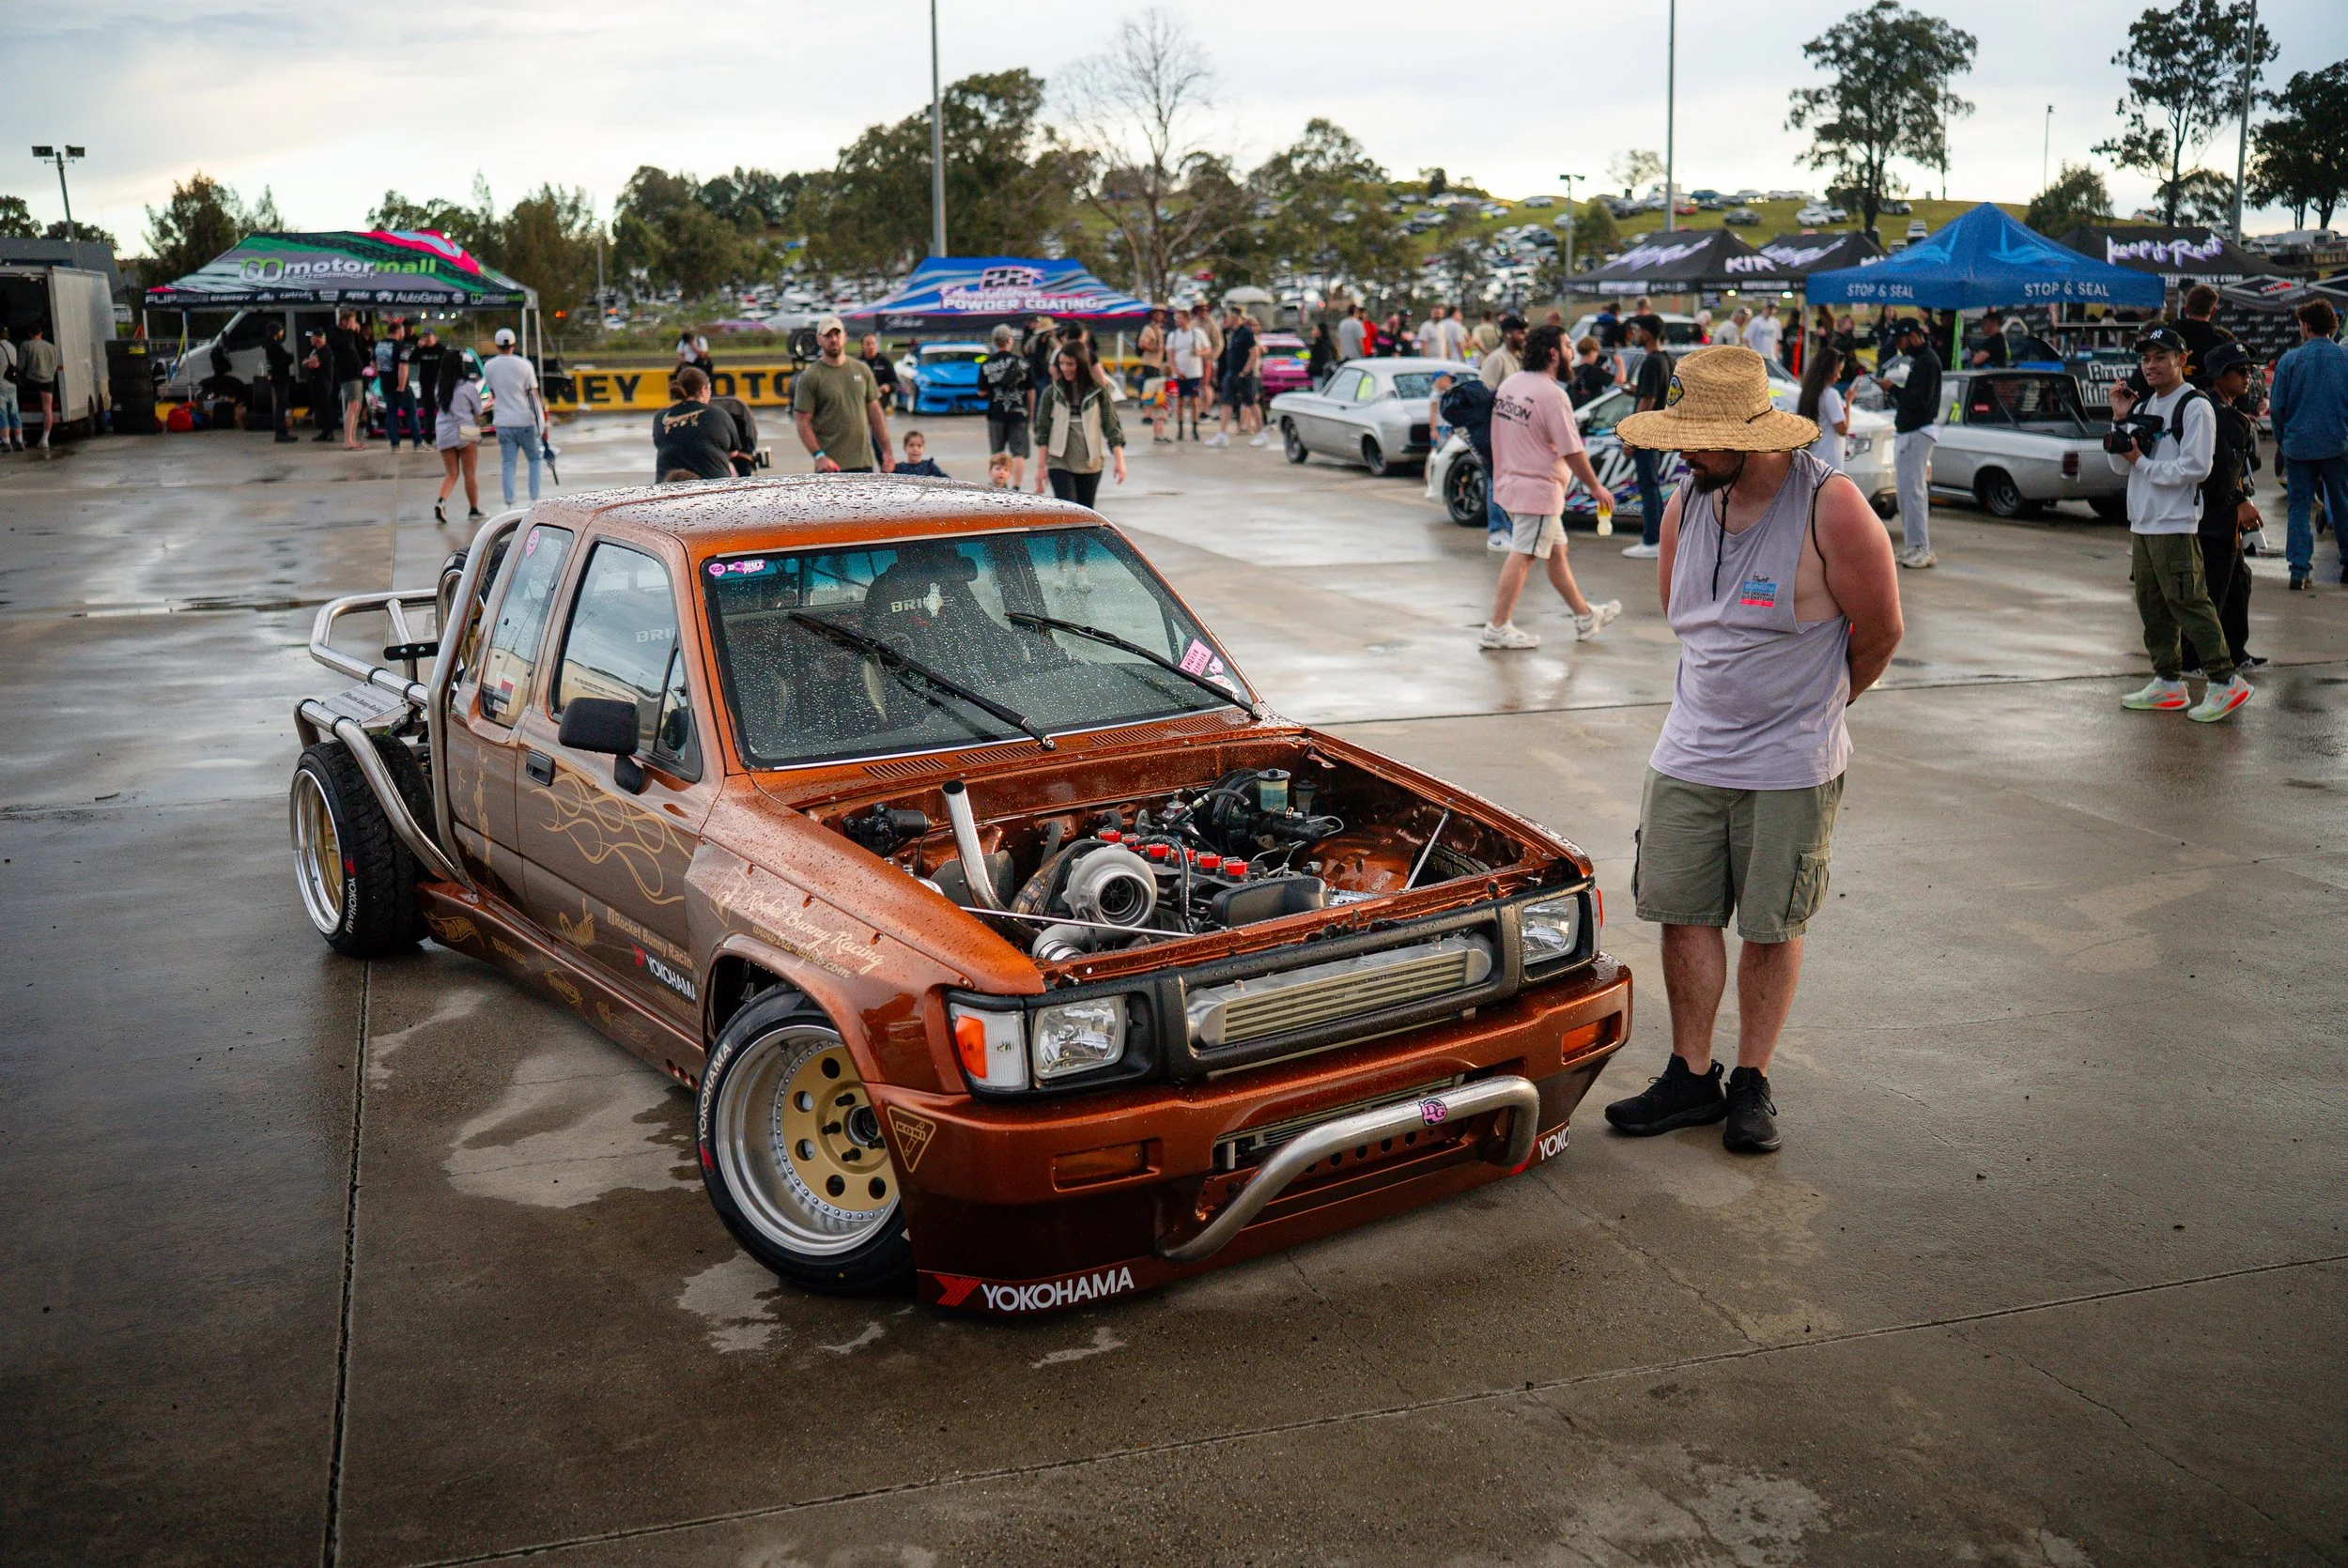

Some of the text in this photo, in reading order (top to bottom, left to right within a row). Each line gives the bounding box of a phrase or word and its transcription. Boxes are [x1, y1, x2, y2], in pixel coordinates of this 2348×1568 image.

[283, 256, 437, 275] motormall
[395, 291, 447, 304] AutoGrab
[1846, 284, 1914, 299] STOP & SEAL
[2024, 281, 2110, 297] STOP & SEAL
[942, 297, 1098, 311] POWDER COATING
[346, 877, 357, 935] YOKOHAMA
[614, 911, 641, 940] Rocket
[642, 927, 668, 958] Bunny
[783, 910, 833, 951] Bunny
[830, 930, 887, 976] Racing
[699, 1041, 733, 1143] YOKOHAMA
[895, 1120, 926, 1142] KONI
[981, 1266, 1135, 1312] YOKOHAMA
